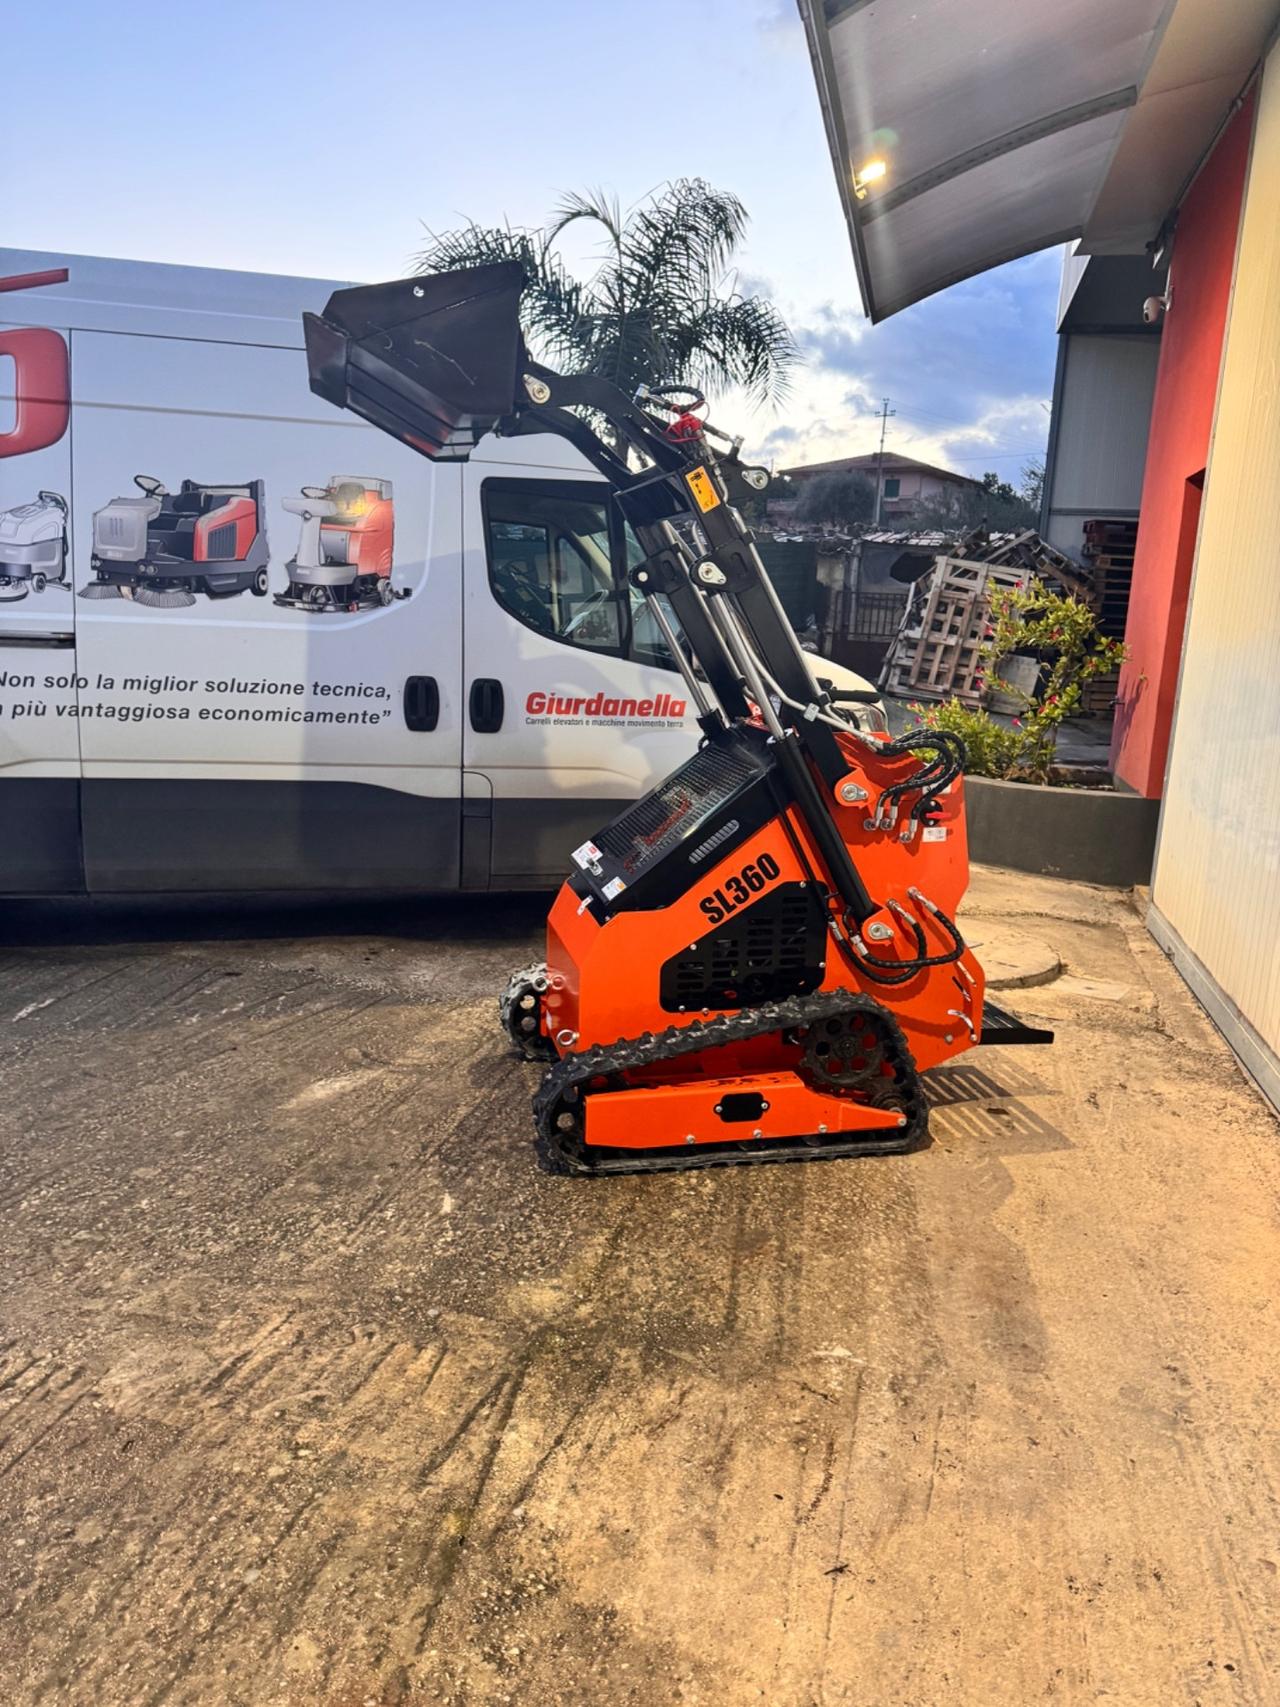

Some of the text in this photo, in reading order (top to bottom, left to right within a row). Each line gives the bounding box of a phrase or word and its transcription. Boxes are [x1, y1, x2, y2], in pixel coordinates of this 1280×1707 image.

[43, 673, 89, 691] solo
[95, 674, 115, 692] la
[122, 674, 199, 696] miglior
[204, 678, 305, 697] soluzione
[312, 681, 392, 701] tecnica,
[11, 700, 47, 719] più
[55, 702, 191, 722] vantaggiosa
[526, 692, 687, 717] Giurdanella
[525, 716, 551, 725] Carrelli
[553, 717, 584, 726] elevatori
[591, 718, 625, 727] macchine
[626, 719, 666, 728] movimento
[666, 719, 684, 728] terra
[699, 852, 780, 924] SL360
